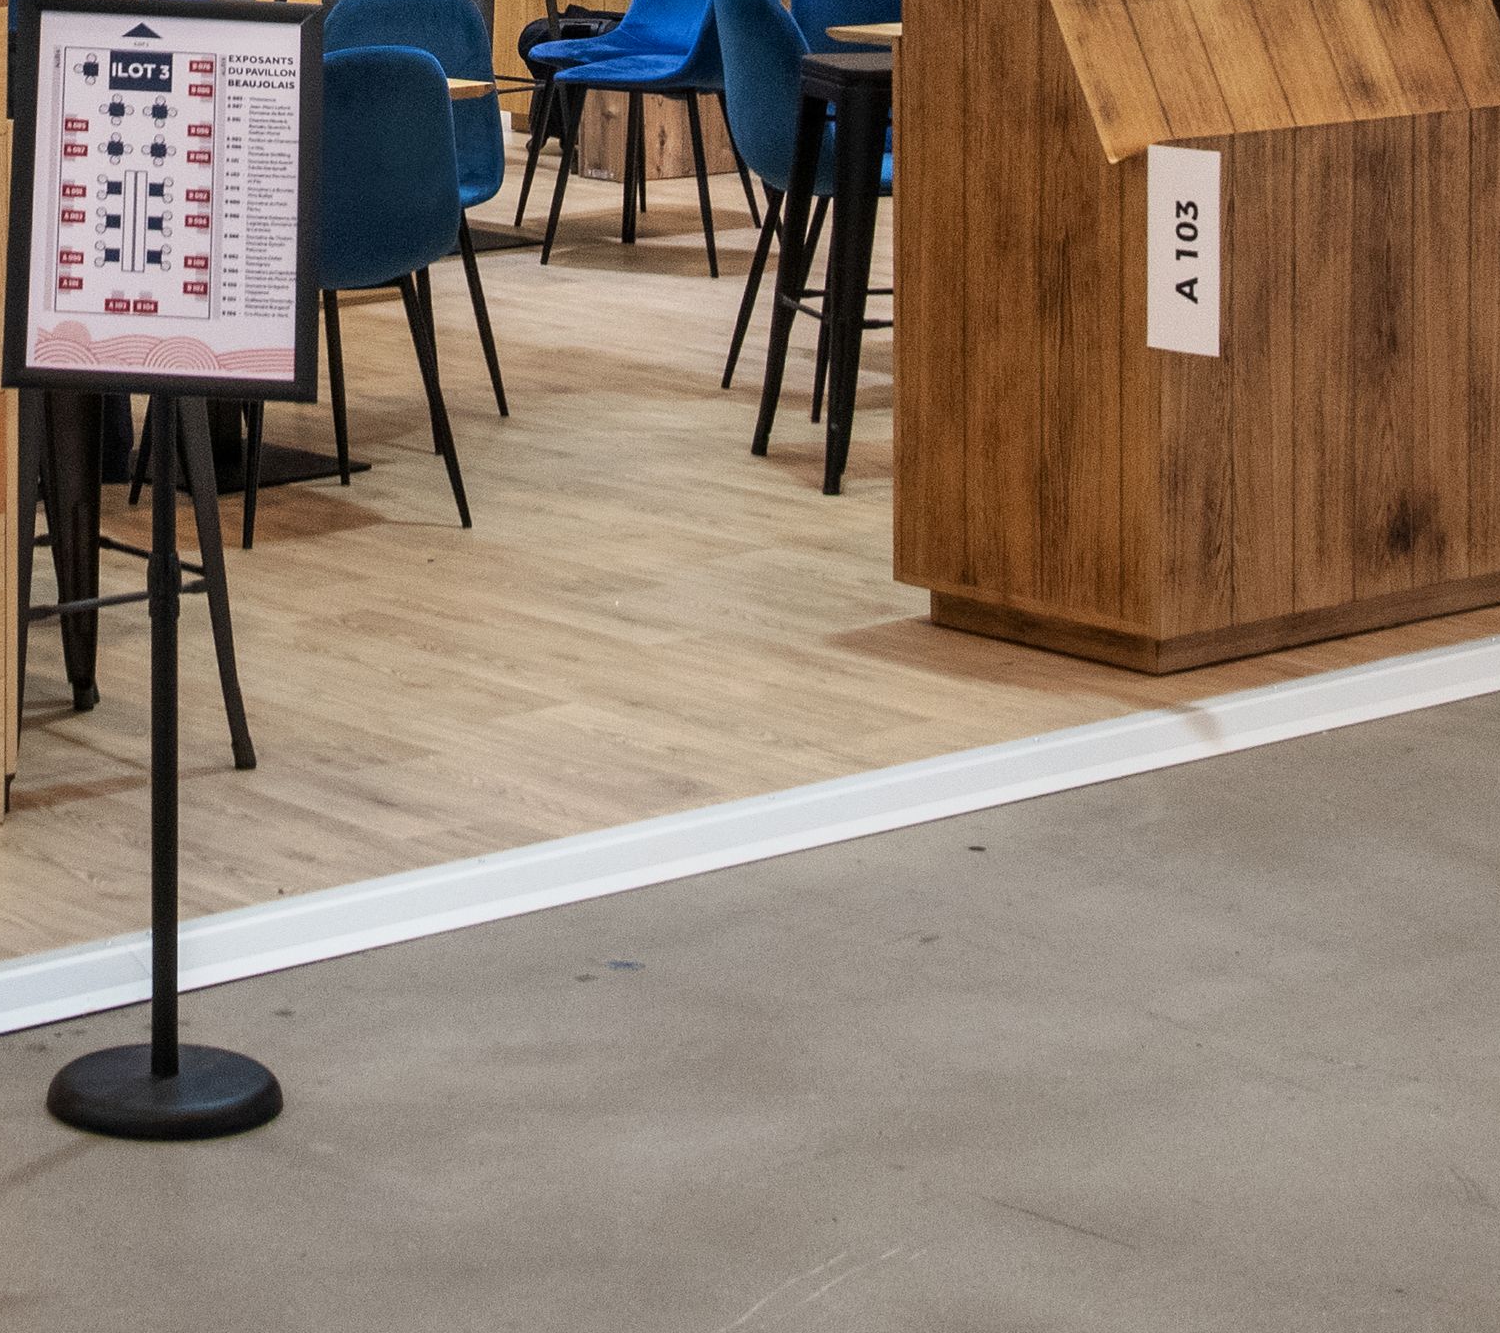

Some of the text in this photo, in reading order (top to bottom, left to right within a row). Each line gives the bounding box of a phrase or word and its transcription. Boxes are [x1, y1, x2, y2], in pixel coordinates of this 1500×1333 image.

[229, 55, 294, 66] EXPOSANTS
[111, 62, 170, 80] ILOT 3
[229, 67, 296, 78] DU PAVILLON
[229, 79, 296, 90] BEAUJOLAIS
[1175, 199, 1199, 304] A 103
